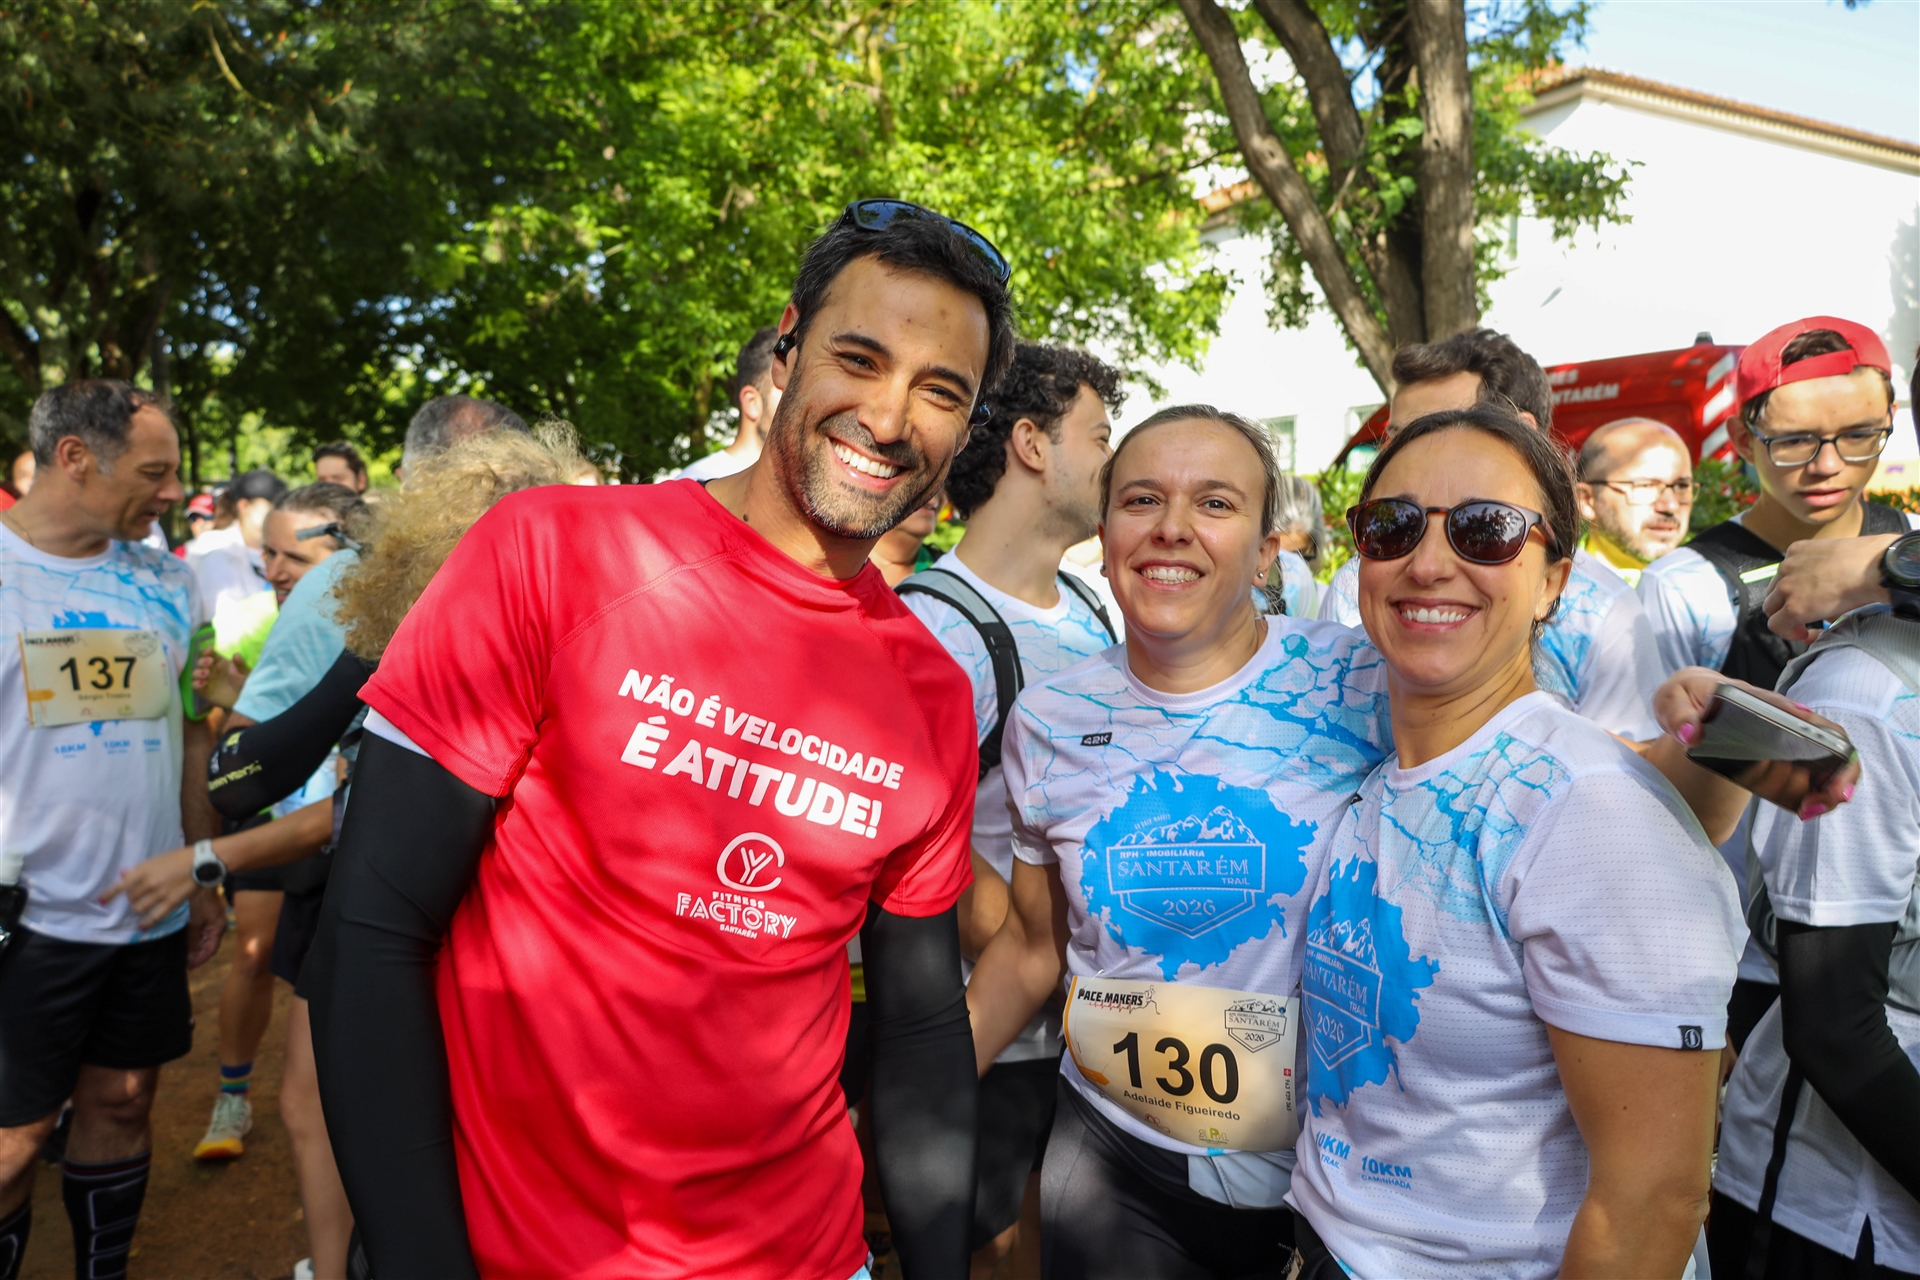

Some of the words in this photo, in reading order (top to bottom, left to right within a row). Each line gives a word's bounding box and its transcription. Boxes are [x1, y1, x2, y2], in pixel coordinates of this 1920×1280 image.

[1551, 382, 1620, 405] NTARÉM
[59, 656, 137, 691] 137
[618, 668, 695, 717] NÃO
[695, 694, 722, 728] É
[724, 706, 905, 790] VELOCIDADE
[620, 715, 670, 770] É
[661, 738, 883, 839] ATITUDE!
[1120, 850, 1139, 859] RPH
[1146, 848, 1206, 858] IMOBILIÁRIA
[1117, 854, 1250, 877] SANTARÉM
[1221, 877, 1250, 886] TRAIL
[712, 891, 765, 909] FITNESS
[1162, 898, 1217, 916] 2026
[675, 892, 797, 939] FACTORY
[719, 924, 758, 940] SANTARÉM
[1303, 958, 1368, 1005] SANTARÉM
[1348, 1000, 1368, 1017] TRAIL
[1228, 1015, 1280, 1029] SANTARÉM
[1316, 1011, 1345, 1043] 2026
[1244, 1032, 1265, 1043] 2026
[1113, 1031, 1240, 1104] 130
[1123, 1089, 1173, 1109] Adelaide
[1175, 1101, 1241, 1121] Figueiredo
[1315, 1130, 1351, 1160] 10KM
[1321, 1153, 1340, 1170] TRAIL
[1361, 1155, 1413, 1179] 10KM
[1361, 1174, 1412, 1191] CAMINHADA
